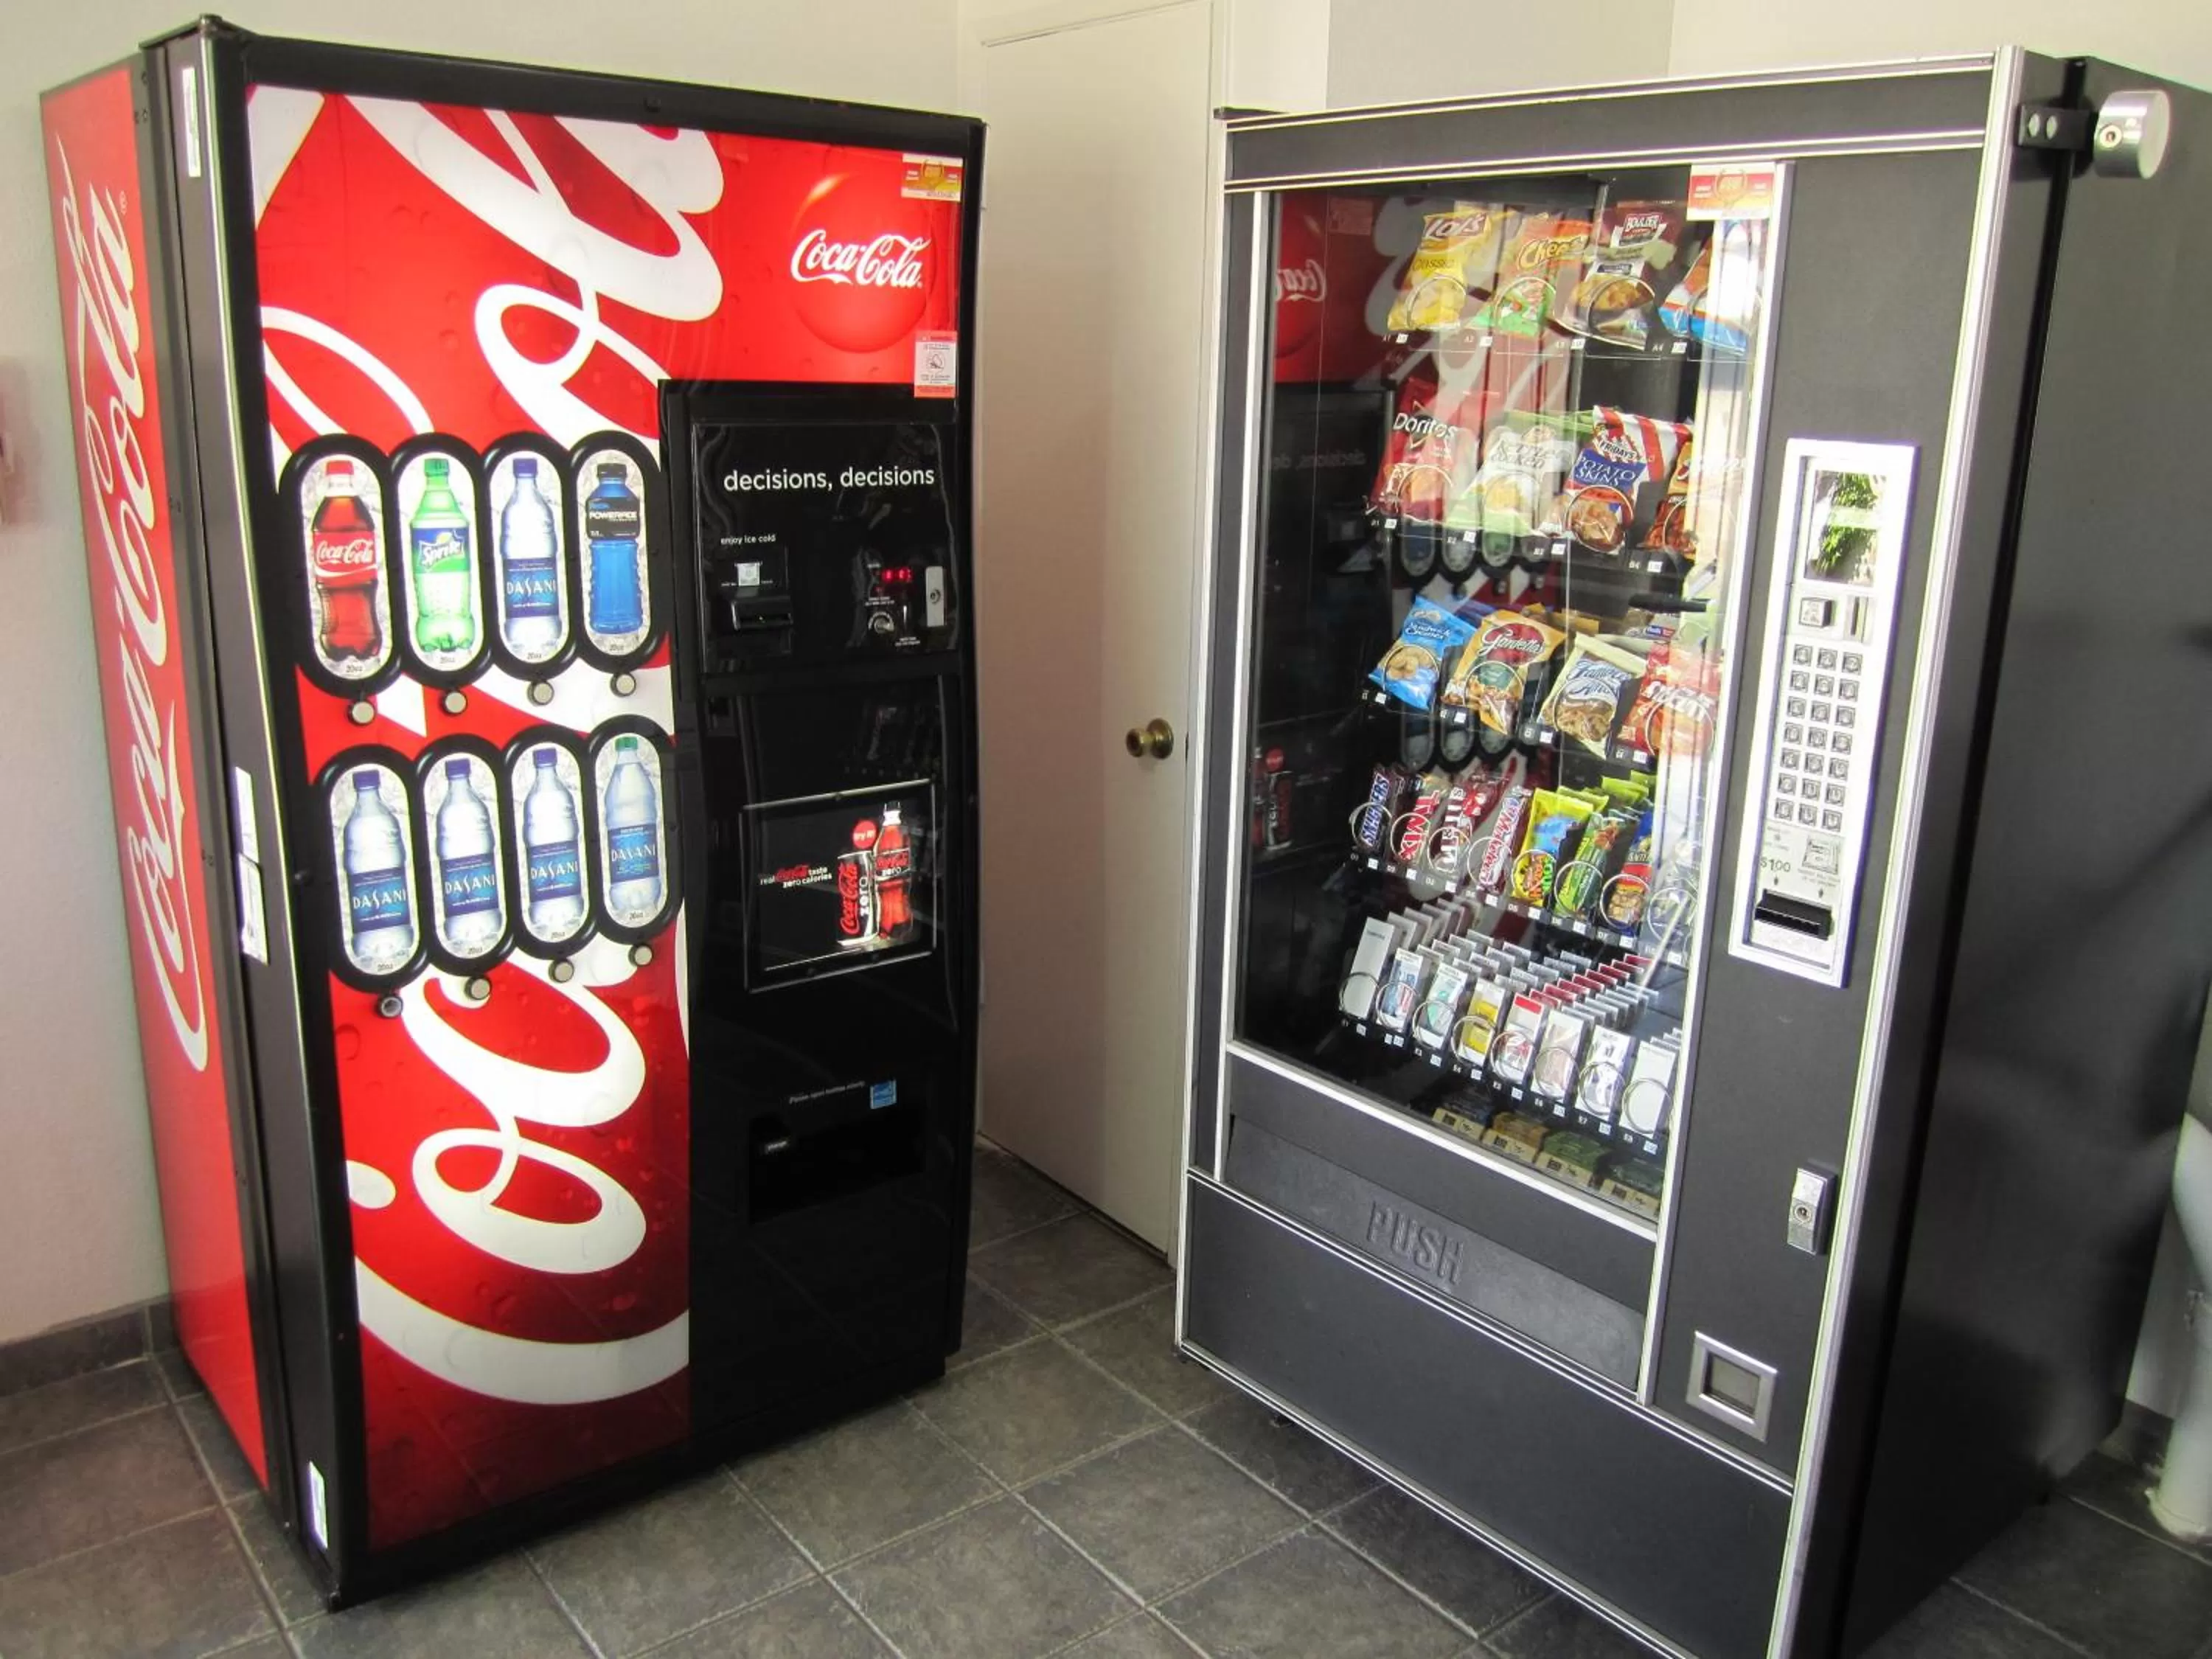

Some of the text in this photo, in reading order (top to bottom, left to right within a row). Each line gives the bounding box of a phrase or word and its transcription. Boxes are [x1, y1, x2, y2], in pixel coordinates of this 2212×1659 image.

[791, 229, 931, 288] Coca-Cola
[1393, 412, 1458, 440] Doritos
[723, 465, 935, 491] decisions, decisions
[720, 534, 776, 546] enjoy ice cold
[506, 577, 556, 597] DASANI
[1361, 773, 1391, 847] SNICKERS
[611, 844, 655, 863] DASANI
[530, 860, 578, 880] DASANI
[444, 873, 495, 895] DASANI
[352, 888, 407, 909] DASANI
[1366, 1200, 1465, 1287] PUSH
